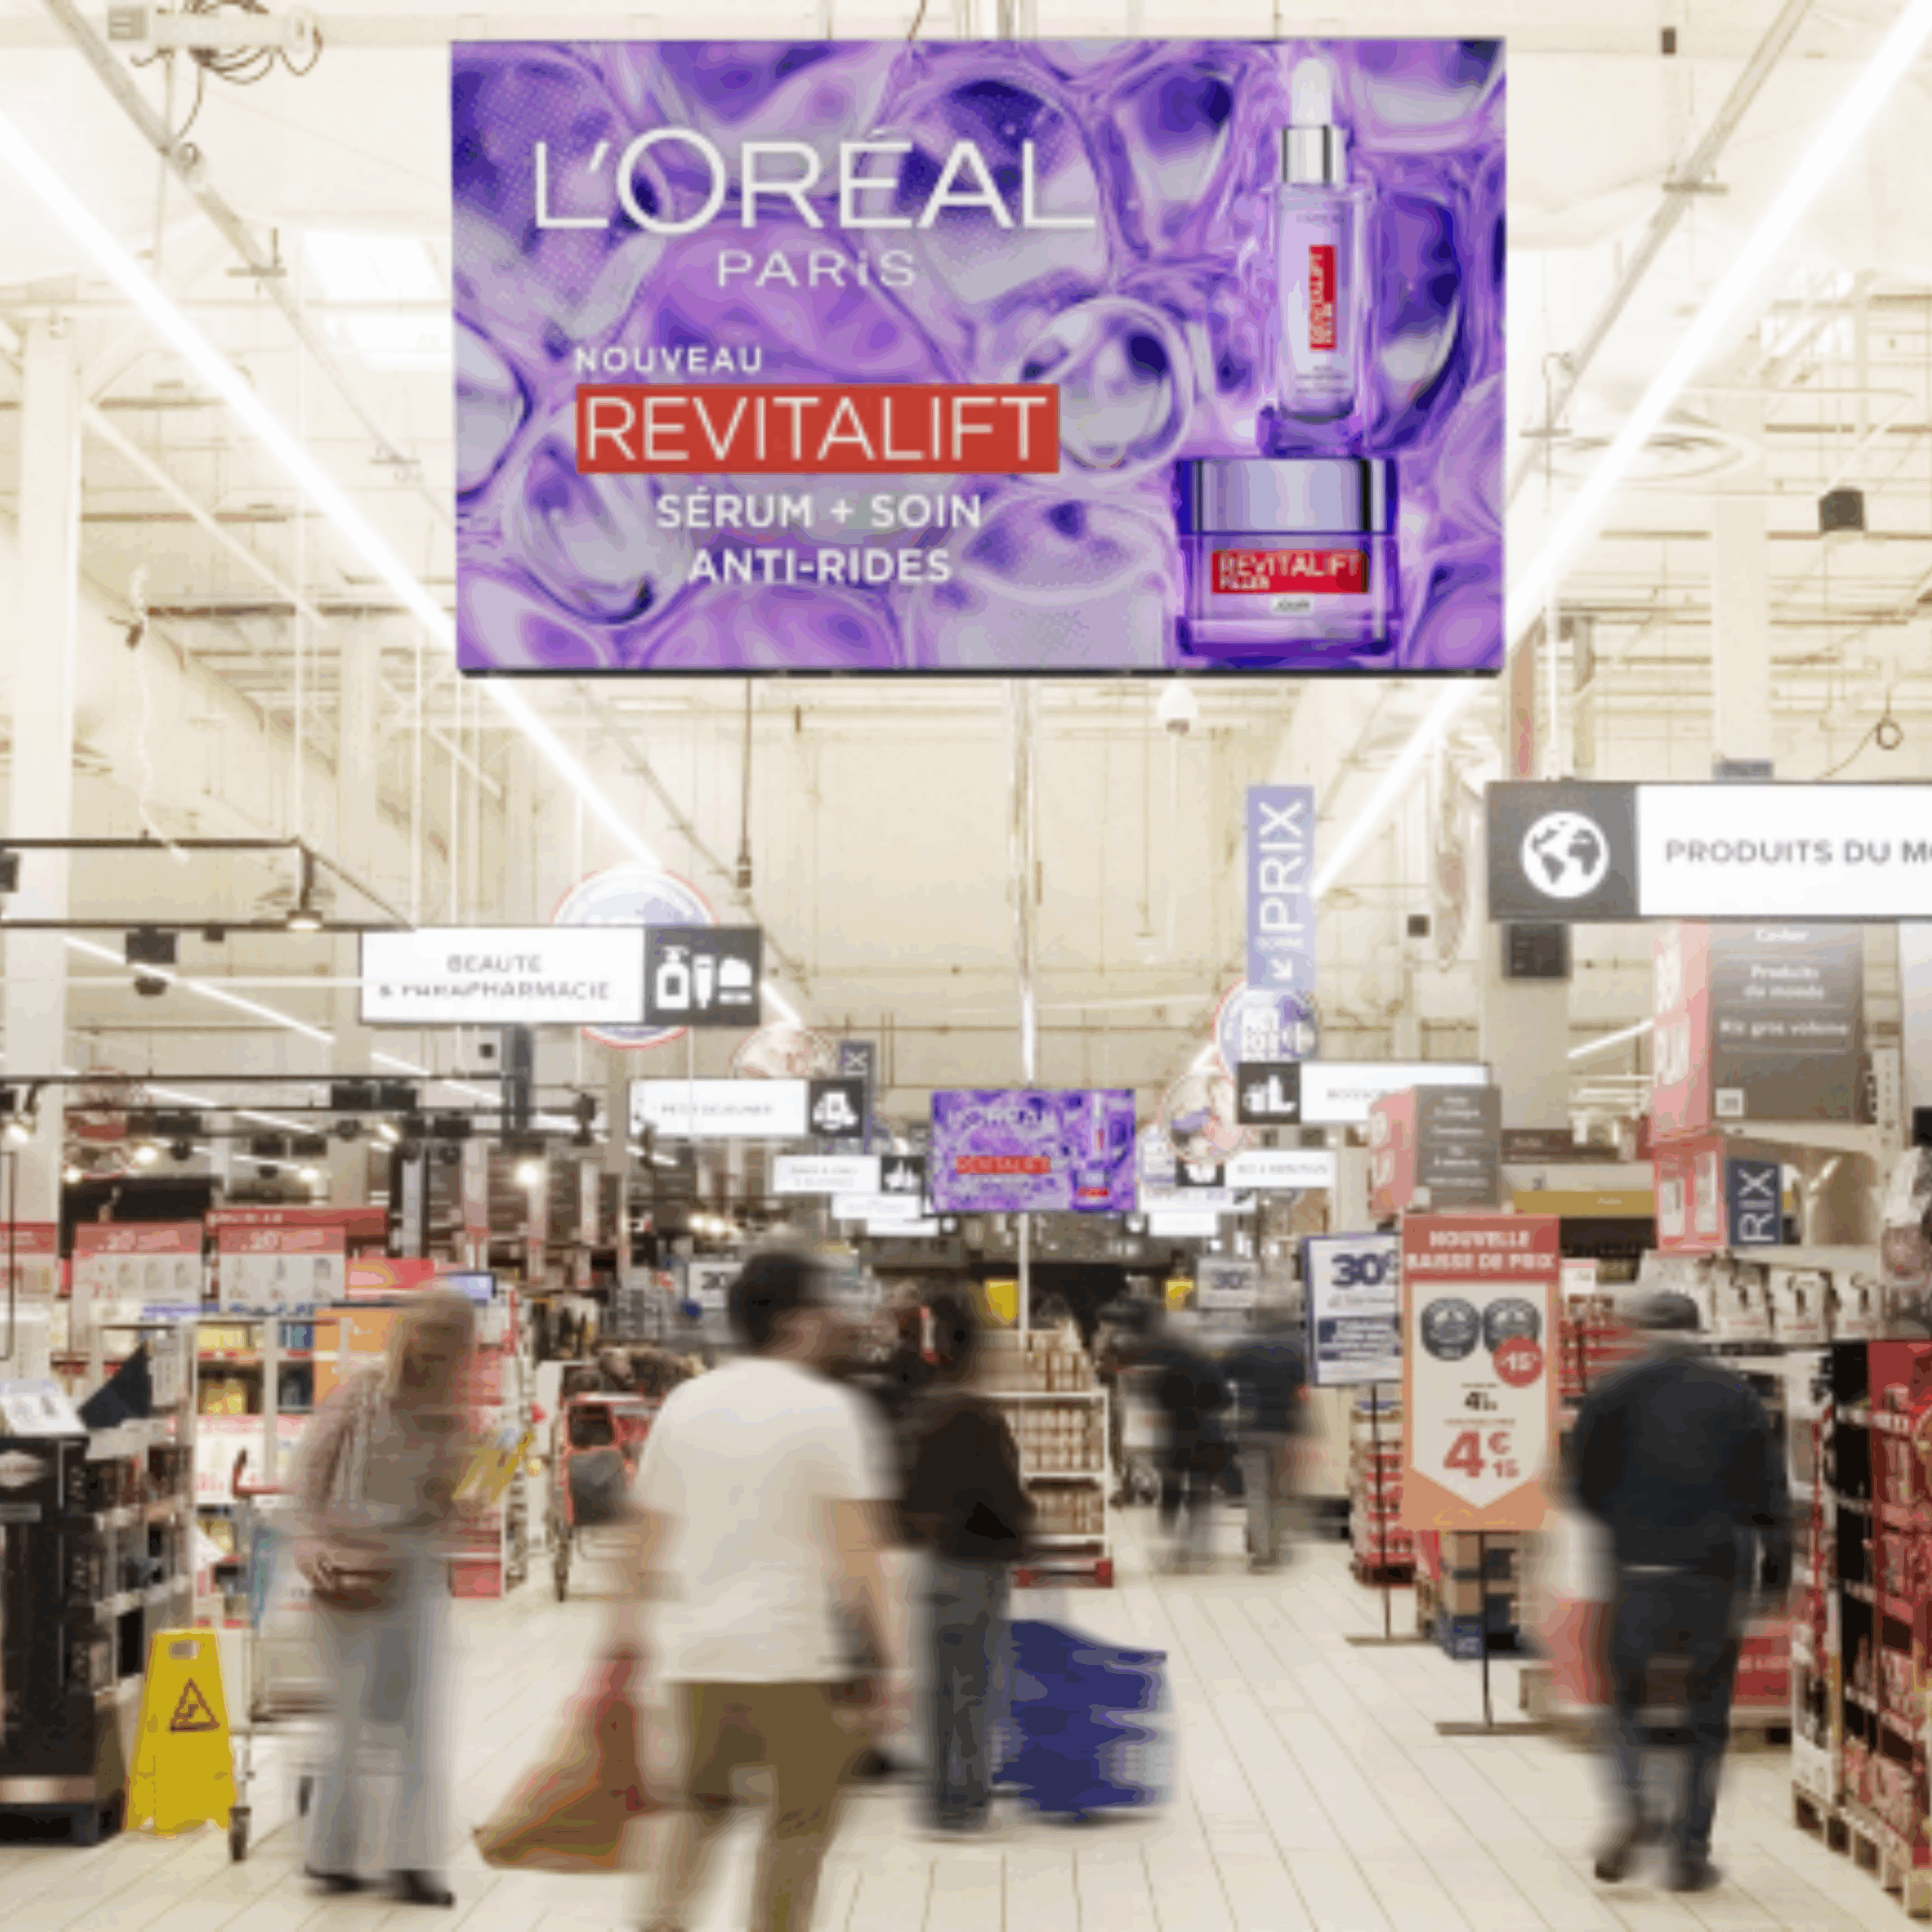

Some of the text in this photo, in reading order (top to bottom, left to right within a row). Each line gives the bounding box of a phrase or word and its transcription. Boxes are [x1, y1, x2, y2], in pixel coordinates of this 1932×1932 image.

[535, 127, 1096, 235] L'ORÉAL
[575, 347, 762, 374] NOUVEAU
[586, 395, 1049, 461] REVITALIFT
[657, 485, 982, 529] SÉRUM + SOIN
[687, 549, 952, 586] ANTI-RIDES
[1666, 838, 1932, 866] PRODUITS DU M
